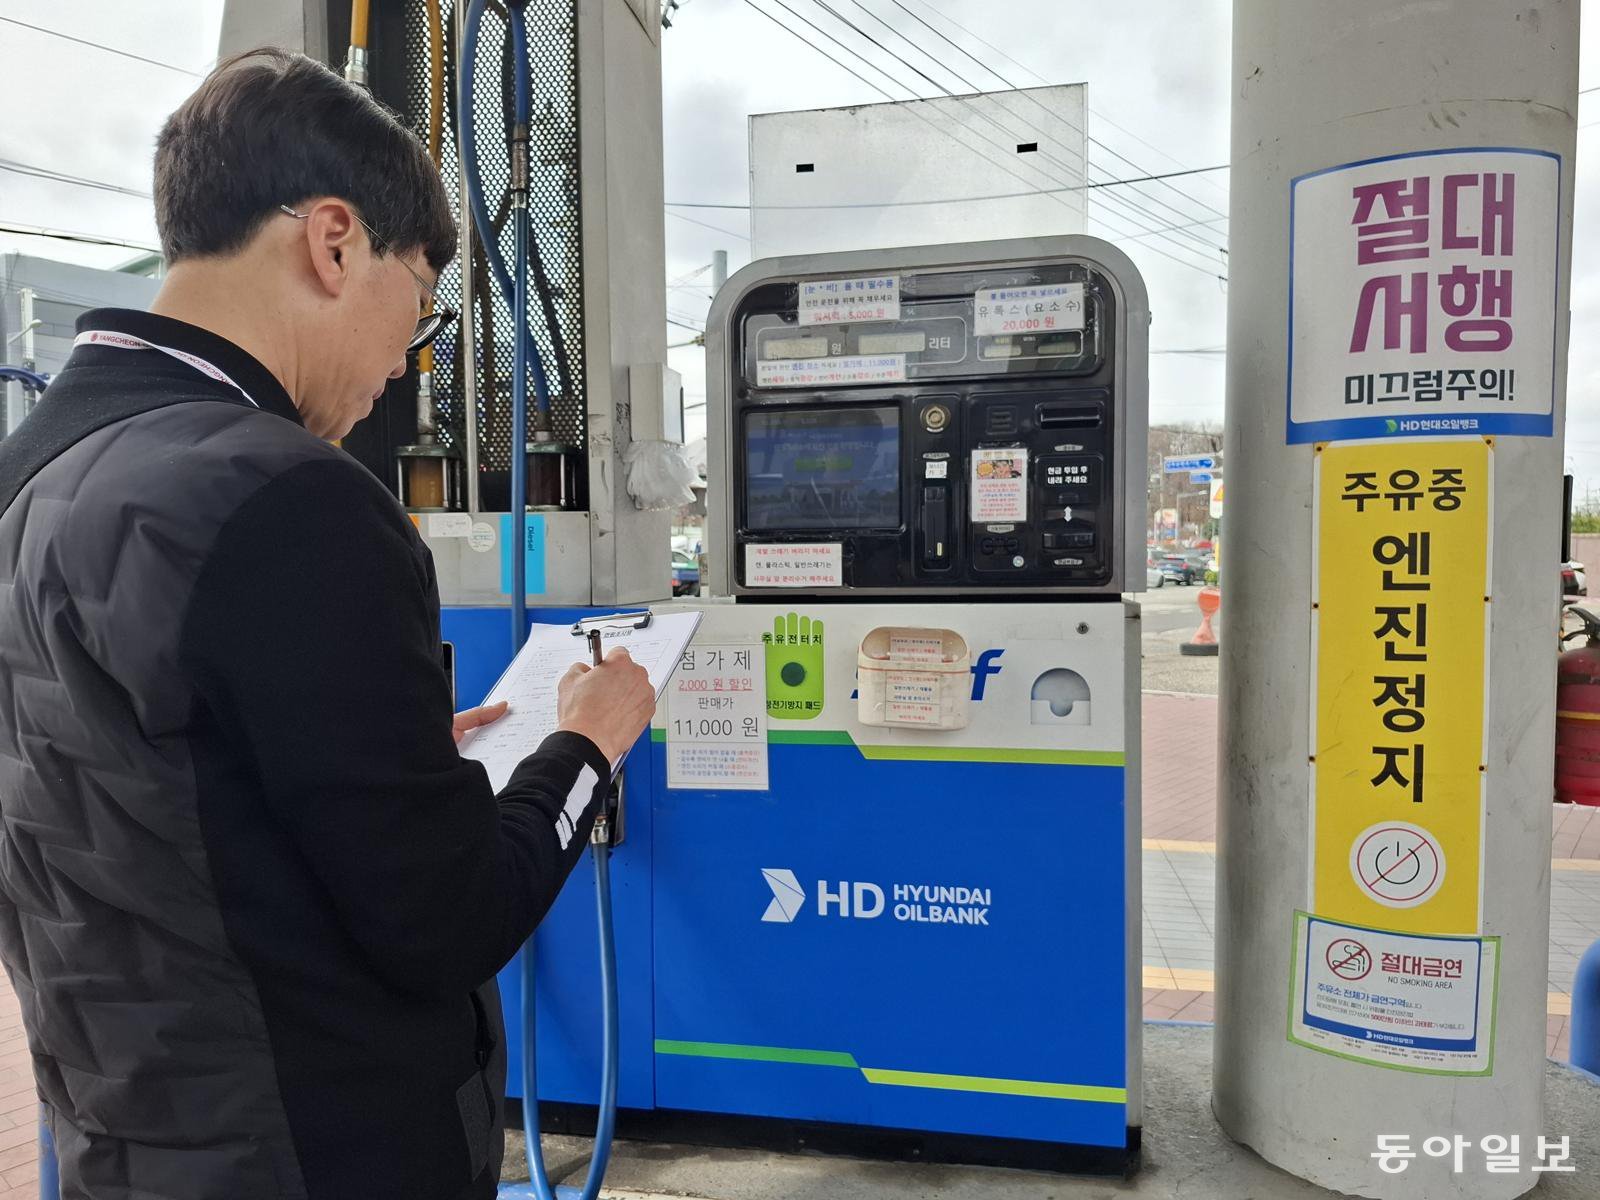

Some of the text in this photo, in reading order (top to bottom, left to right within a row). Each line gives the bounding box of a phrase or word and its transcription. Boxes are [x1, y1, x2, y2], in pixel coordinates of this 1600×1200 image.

[1351, 173, 1515, 266] 절대
[848, 310, 873, 320] 5,000
[1349, 265, 1513, 354] 서행
[1003, 316, 1056, 330] 20,000 원
[831, 343, 841, 355] 원
[928, 337, 951, 349] 리터
[1345, 369, 1515, 405] 미끄럼주의!
[1064, 466, 1078, 475] 투입
[1065, 475, 1088, 484] 주세요
[1341, 468, 1467, 512] 주유중
[527, 526, 535, 552] Diesel
[1370, 531, 1431, 803] 엔진정지
[678, 678, 753, 692] 2,000 원 할인
[698, 697, 734, 710] 판매가
[674, 717, 759, 738] 11,000 원
[817, 879, 886, 918] HD
[893, 884, 991, 905] HYUNDAI
[893, 904, 989, 926] OILBANK
[1381, 952, 1462, 979] 절대금연
[1317, 982, 1342, 996] 주유소
[1343, 988, 1369, 1002] 전체가
[1387, 976, 1453, 989] NO SMOKING AREA
